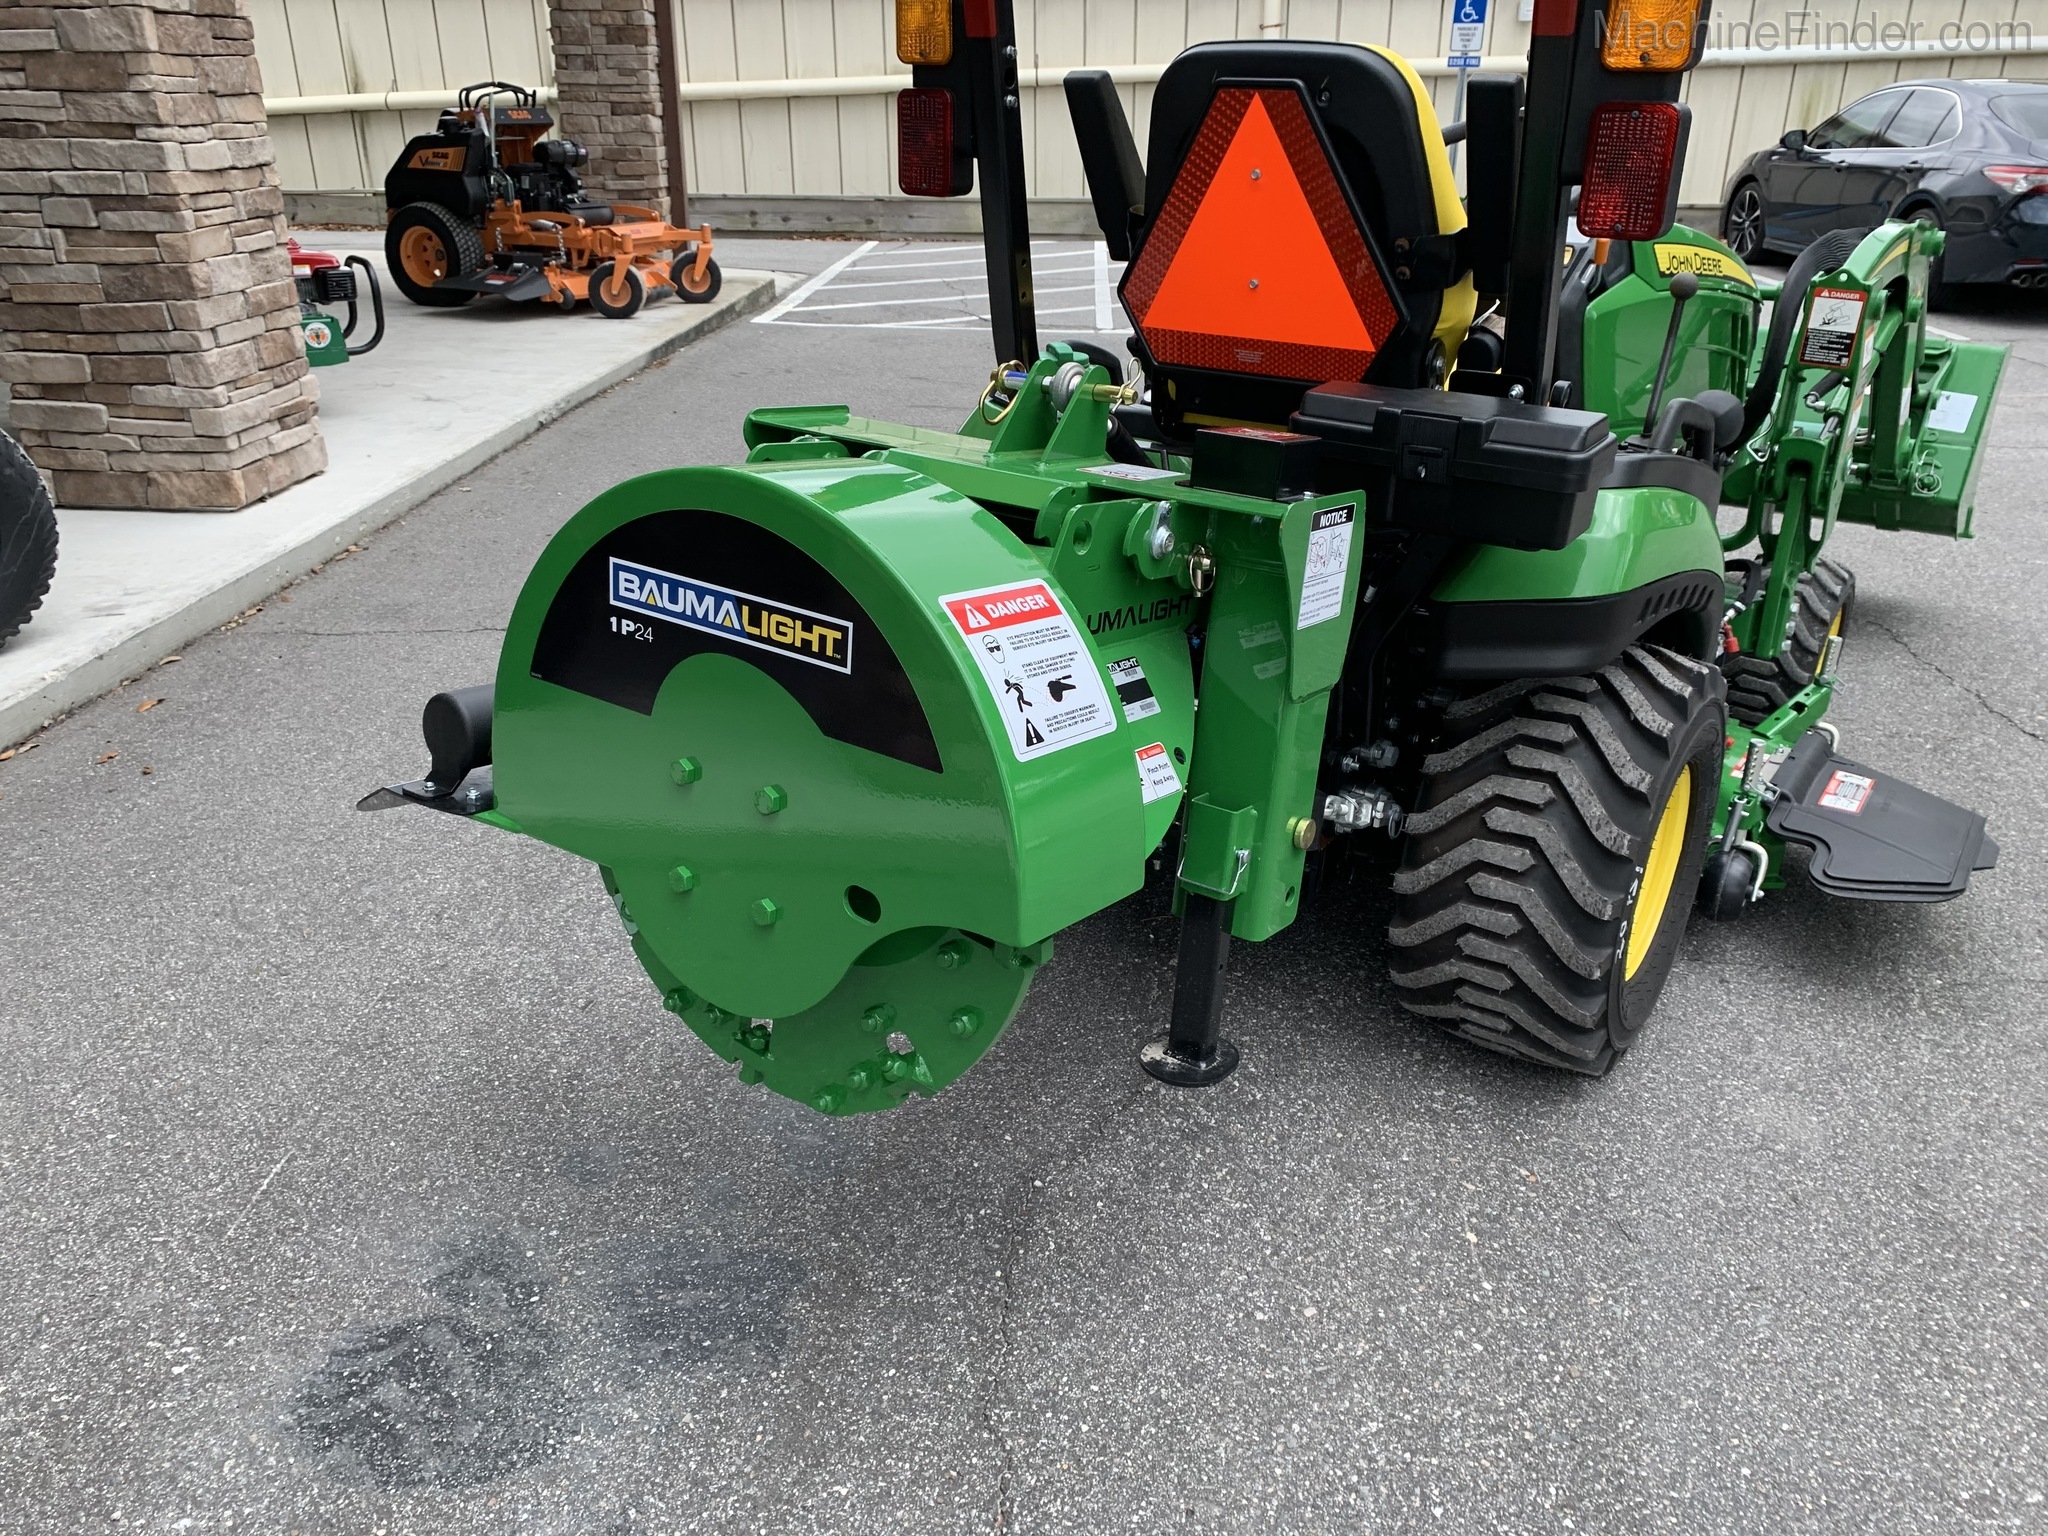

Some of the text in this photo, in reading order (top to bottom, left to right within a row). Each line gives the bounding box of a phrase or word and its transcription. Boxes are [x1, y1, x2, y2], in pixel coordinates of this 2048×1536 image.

[507, 110, 532, 120] SCAG
[1666, 252, 1723, 273] JOHN DEERE
[1830, 292, 1860, 300] DANGER
[1320, 509, 1348, 528] NOTICE
[618, 570, 842, 657] BAUMALIGHT
[984, 594, 1050, 619] DANGER
[610, 616, 654, 643] 1P24
[1106, 658, 1138, 672] ALIGHT
[1079, 704, 1096, 712] WARNINGS
[1054, 716, 1077, 726] PRECAUTIONS
